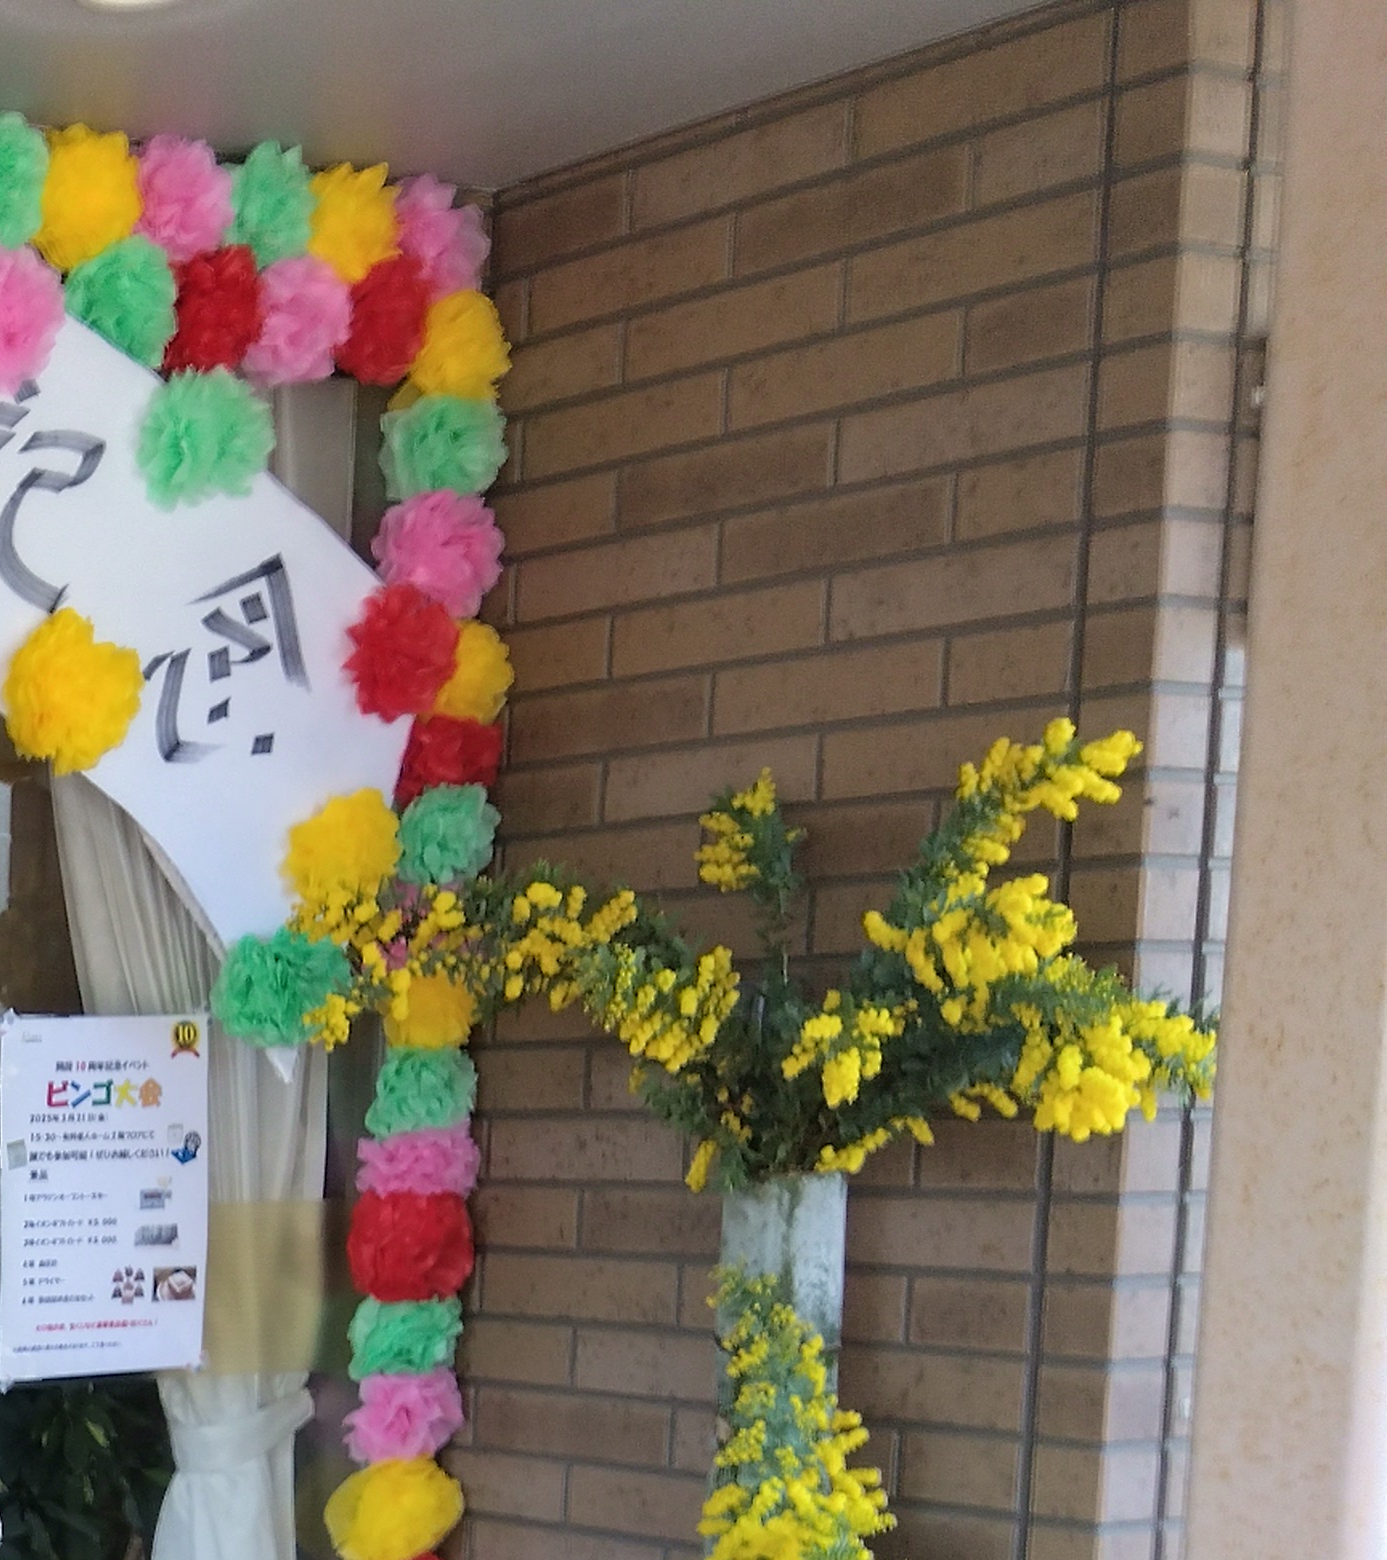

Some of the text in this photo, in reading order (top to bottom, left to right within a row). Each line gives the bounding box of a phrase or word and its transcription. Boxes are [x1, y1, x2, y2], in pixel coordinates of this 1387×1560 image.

[175, 1025, 195, 1042] 10
[47, 1077, 162, 1108] ビンゴ大会
